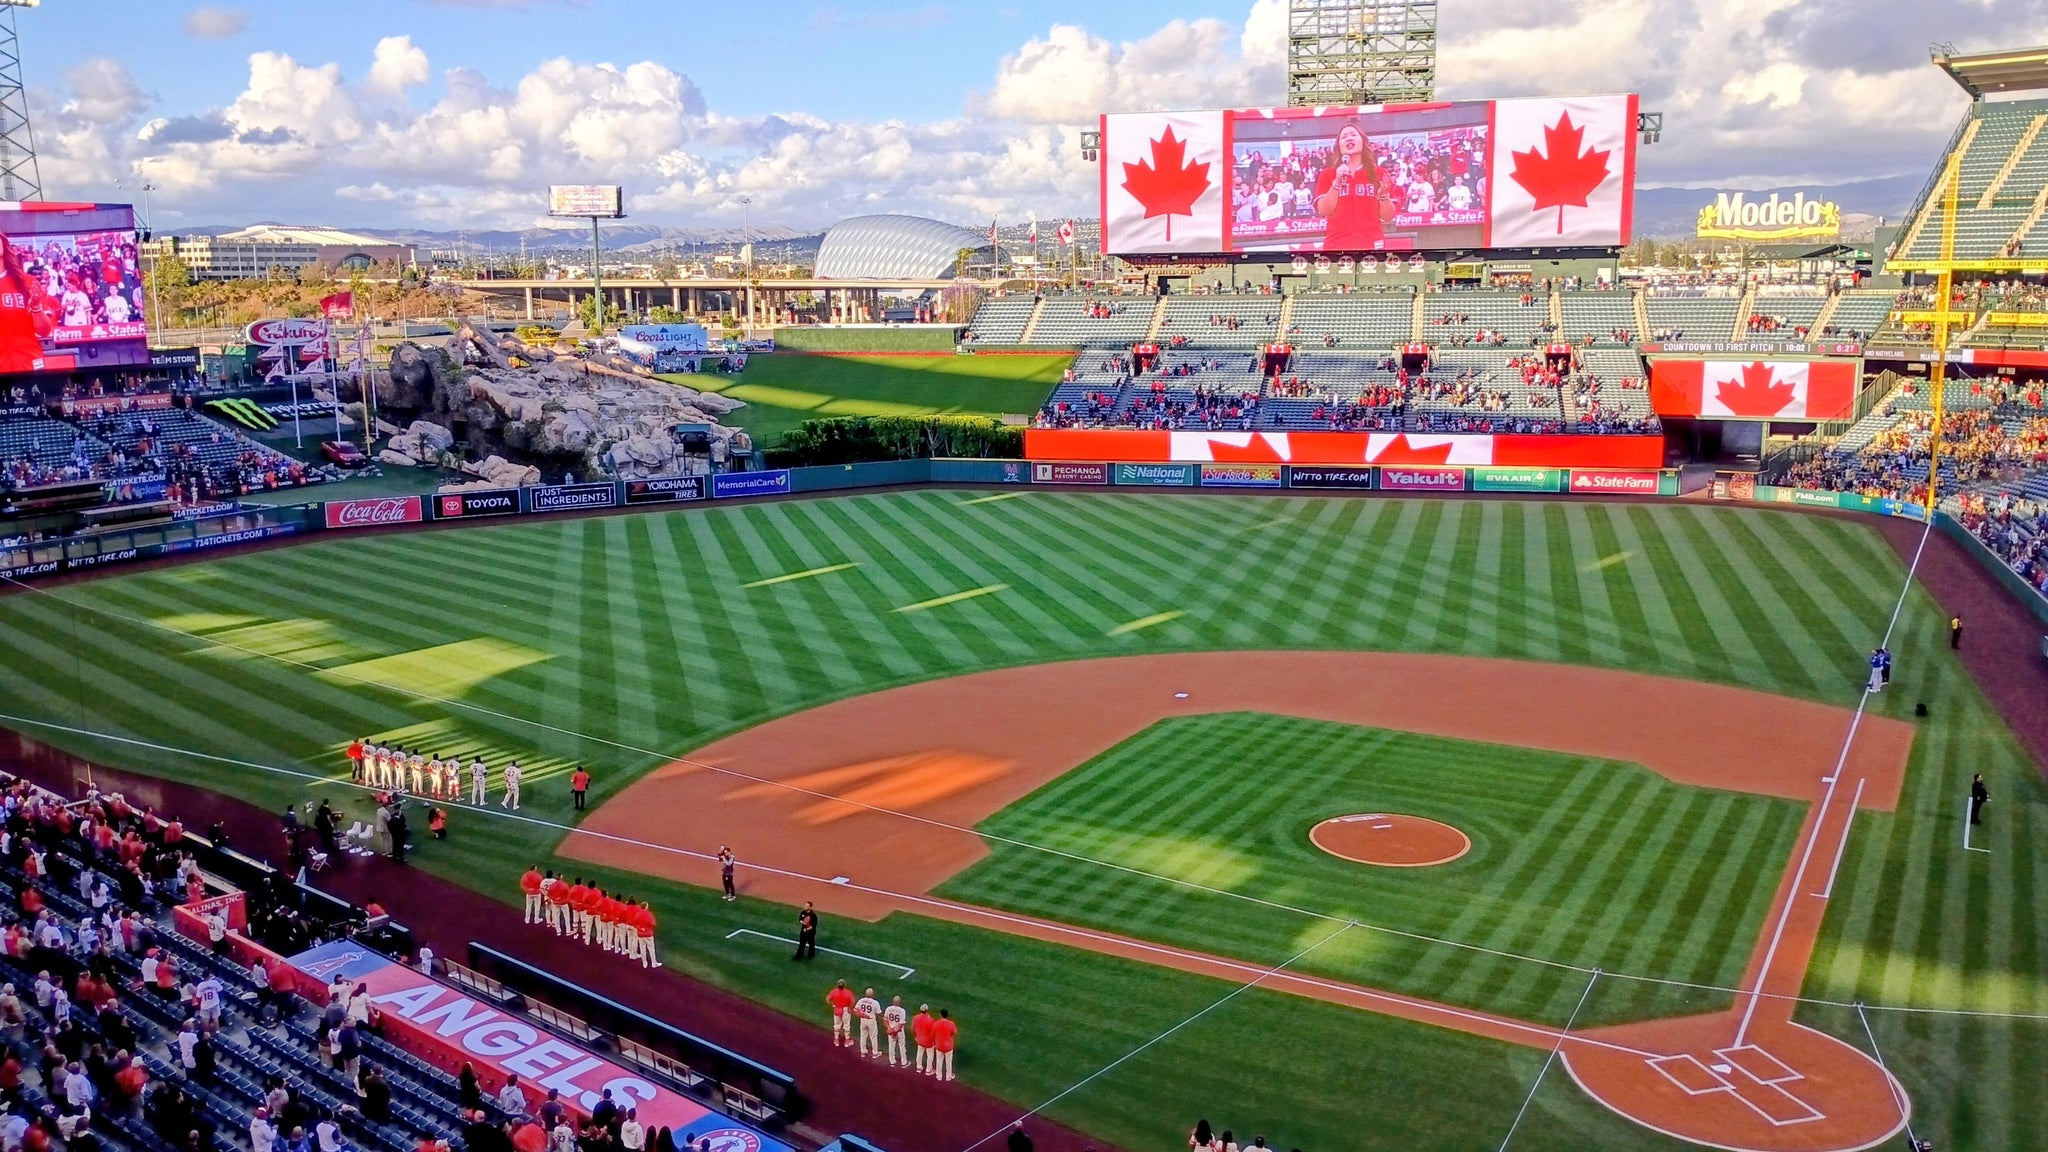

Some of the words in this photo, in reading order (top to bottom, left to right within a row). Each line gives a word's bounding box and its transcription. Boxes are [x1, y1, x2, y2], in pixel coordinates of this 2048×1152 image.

[1716, 192, 1821, 226] Modelo
[635, 331, 665, 342] Coors
[1663, 343, 1712, 352] COUNTDOWN
[1714, 343, 1724, 352] TO
[1726, 343, 1745, 352] FIRST
[1750, 343, 1774, 352] PITCH
[1785, 343, 1806, 352] 10:02
[1836, 344, 1855, 353] 6:27
[151, 354, 173, 365] TEAM
[172, 355, 196, 364] STORE
[1136, 467, 1186, 478] National
[1206, 467, 1251, 481] Surfside
[1293, 472, 1322, 481] NITTO
[1324, 472, 1369, 482] TIRE.COM
[1387, 472, 1459, 485] Yakult
[646, 479, 698, 491] YOKOHAMA
[717, 479, 776, 491] MemorialCare
[1594, 475, 1654, 488] StateFarm
[540, 487, 561, 497] JUST
[675, 490, 698, 499] TIRES
[1795, 492, 1834, 503] FMB.com
[466, 497, 511, 509] TOYOTA
[540, 492, 607, 506] INGREDIENTS
[173, 503, 233, 517] 714TICKETS.COM
[195, 530, 263, 548] 714TICKETS.COM
[68, 558, 95, 568] NITTO
[97, 549, 137, 563] TIRE.COM
[16, 561, 58, 576] TIRE.COM
[191, 900, 223, 913] ALINAS,
[203, 991, 213, 1001] 18
[860, 1003, 872, 1014] 89
[888, 1013, 900, 1023] 86
[370, 983, 657, 1114] ANGELS
